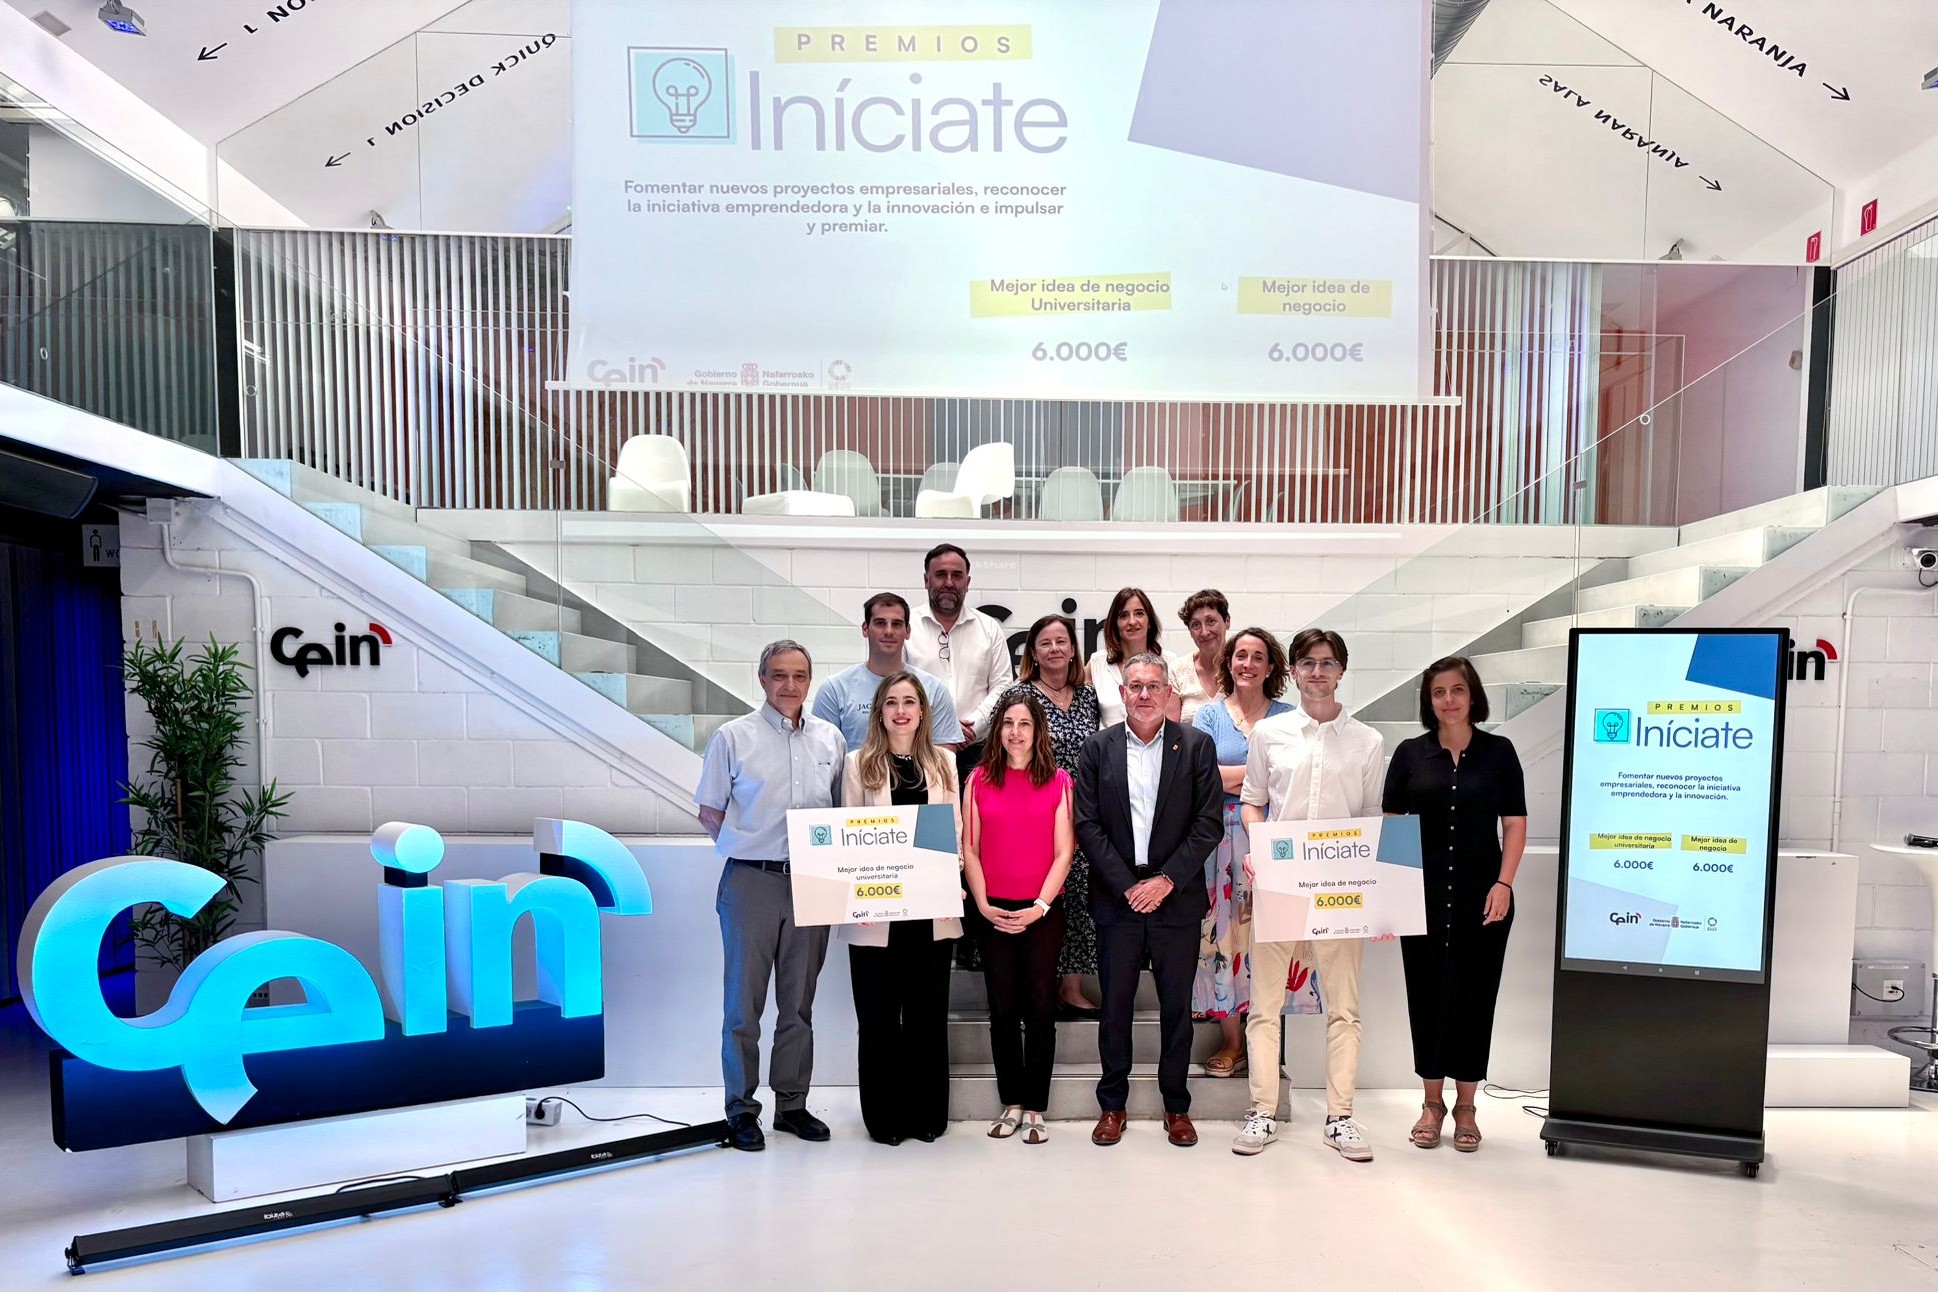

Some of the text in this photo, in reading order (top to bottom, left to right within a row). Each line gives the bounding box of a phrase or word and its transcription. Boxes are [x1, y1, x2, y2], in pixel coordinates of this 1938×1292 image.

[797, 33, 1011, 55] PREMIOS
[1701, 2, 1807, 77] NARANJA
[748, 70, 1069, 154] Iníciate
[624, 180, 1067, 198] Fomentar nuevos proyectos empresariales, reconocer
[627, 199, 1064, 217] la iniciativa emprendedora y la innovación e impulsar
[806, 219, 888, 236] y premiar.
[990, 279, 1170, 296] Mejor idea de negocio
[1262, 280, 1370, 297] Mejor idea de
[1031, 298, 1132, 312] Universitaria
[1282, 299, 1347, 316] negocio
[1031, 341, 1128, 362] 6.000€
[1268, 342, 1364, 362] 6.000€
[1655, 703, 1734, 712] PREMIOS
[1636, 716, 1753, 750] Iníciate
[1618, 771, 1723, 783] Fomentar nuevos proyectos
[1600, 781, 1741, 791] empresariales, reconocer la iniciativa
[1610, 790, 1729, 800] emprendedora y la innovación.
[841, 826, 908, 847] Iníciate
[1597, 833, 1617, 842] Mejor
[1618, 833, 1633, 841] idea
[1644, 834, 1672, 843] negocio
[1691, 836, 1710, 845] Mejor
[1712, 836, 1727, 844] idea
[1302, 840, 1371, 861] Iníciate
[1699, 845, 1727, 853] negocio
[837, 863, 915, 875] Mejor idea de negocio
[1613, 859, 1654, 870] 6.000€
[1692, 863, 1734, 873] 6.000€
[856, 873, 899, 881] universitaria
[1298, 878, 1377, 890] Mejor idea de negocio
[856, 885, 901, 897] 6.000€
[1316, 895, 1361, 907] 6.000€
